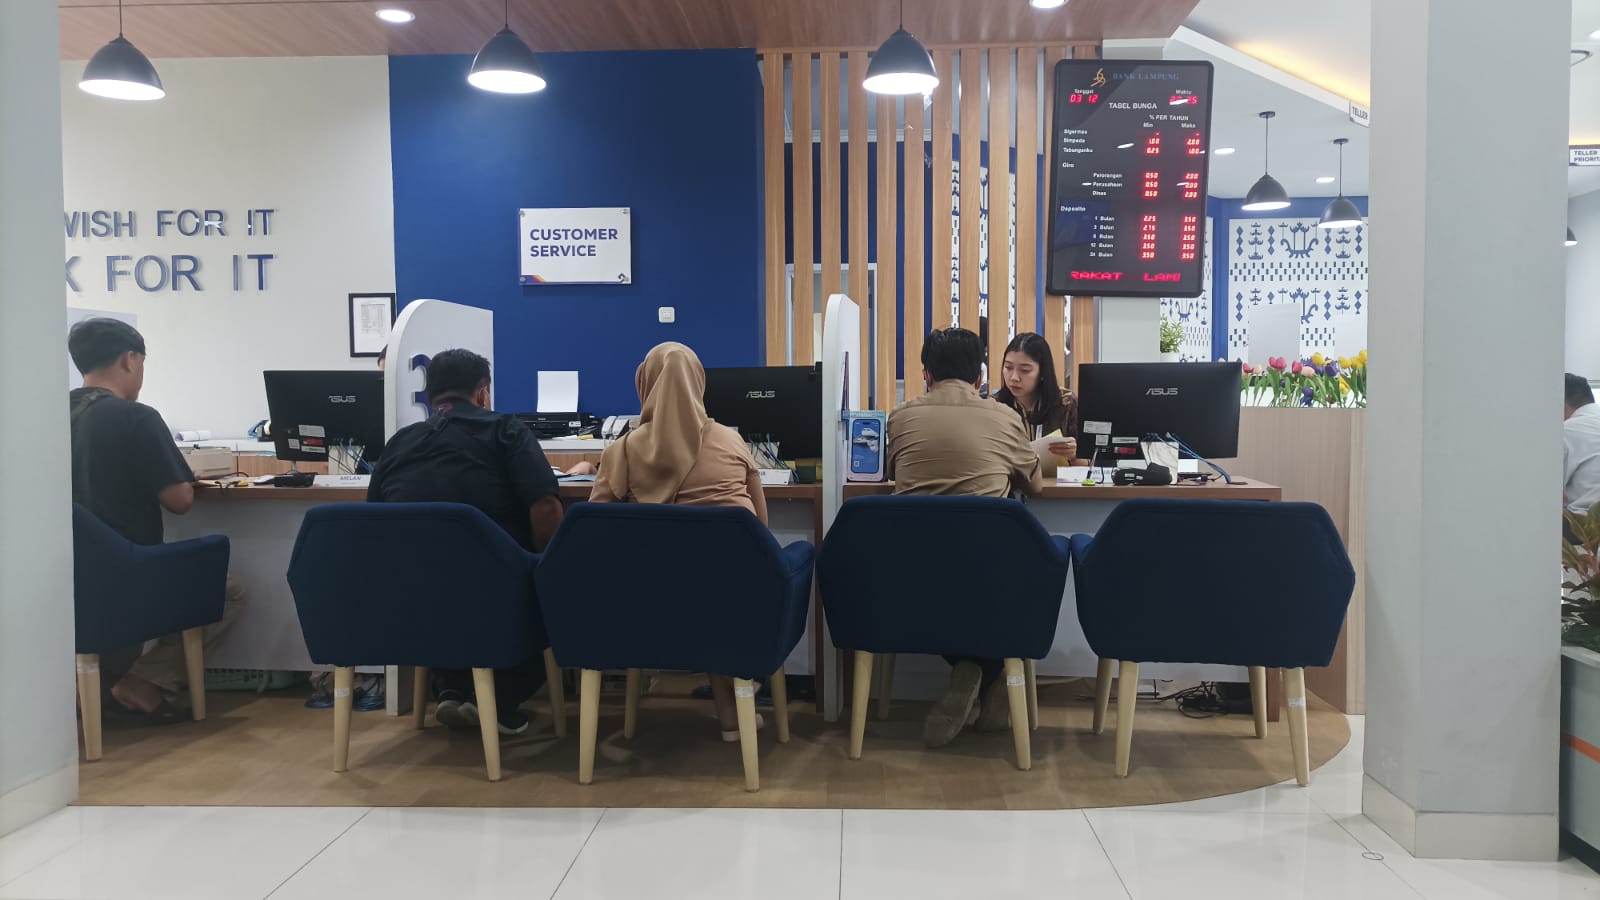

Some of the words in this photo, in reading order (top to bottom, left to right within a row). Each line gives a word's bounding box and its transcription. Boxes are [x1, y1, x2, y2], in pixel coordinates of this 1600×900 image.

[1112, 72, 1134, 81] BANK
[1138, 72, 1180, 81] LAMPUNG
[1352, 106, 1368, 120] TELLER
[157, 209, 226, 237] FOR
[248, 209, 274, 236] IT
[530, 228, 618, 241] CUSTOMER
[530, 245, 596, 257] SERVICE
[106, 255, 202, 293] FOR
[232, 253, 274, 291] IT
[746, 390, 776, 398] ASUS
[1145, 387, 1179, 396] ASUS
